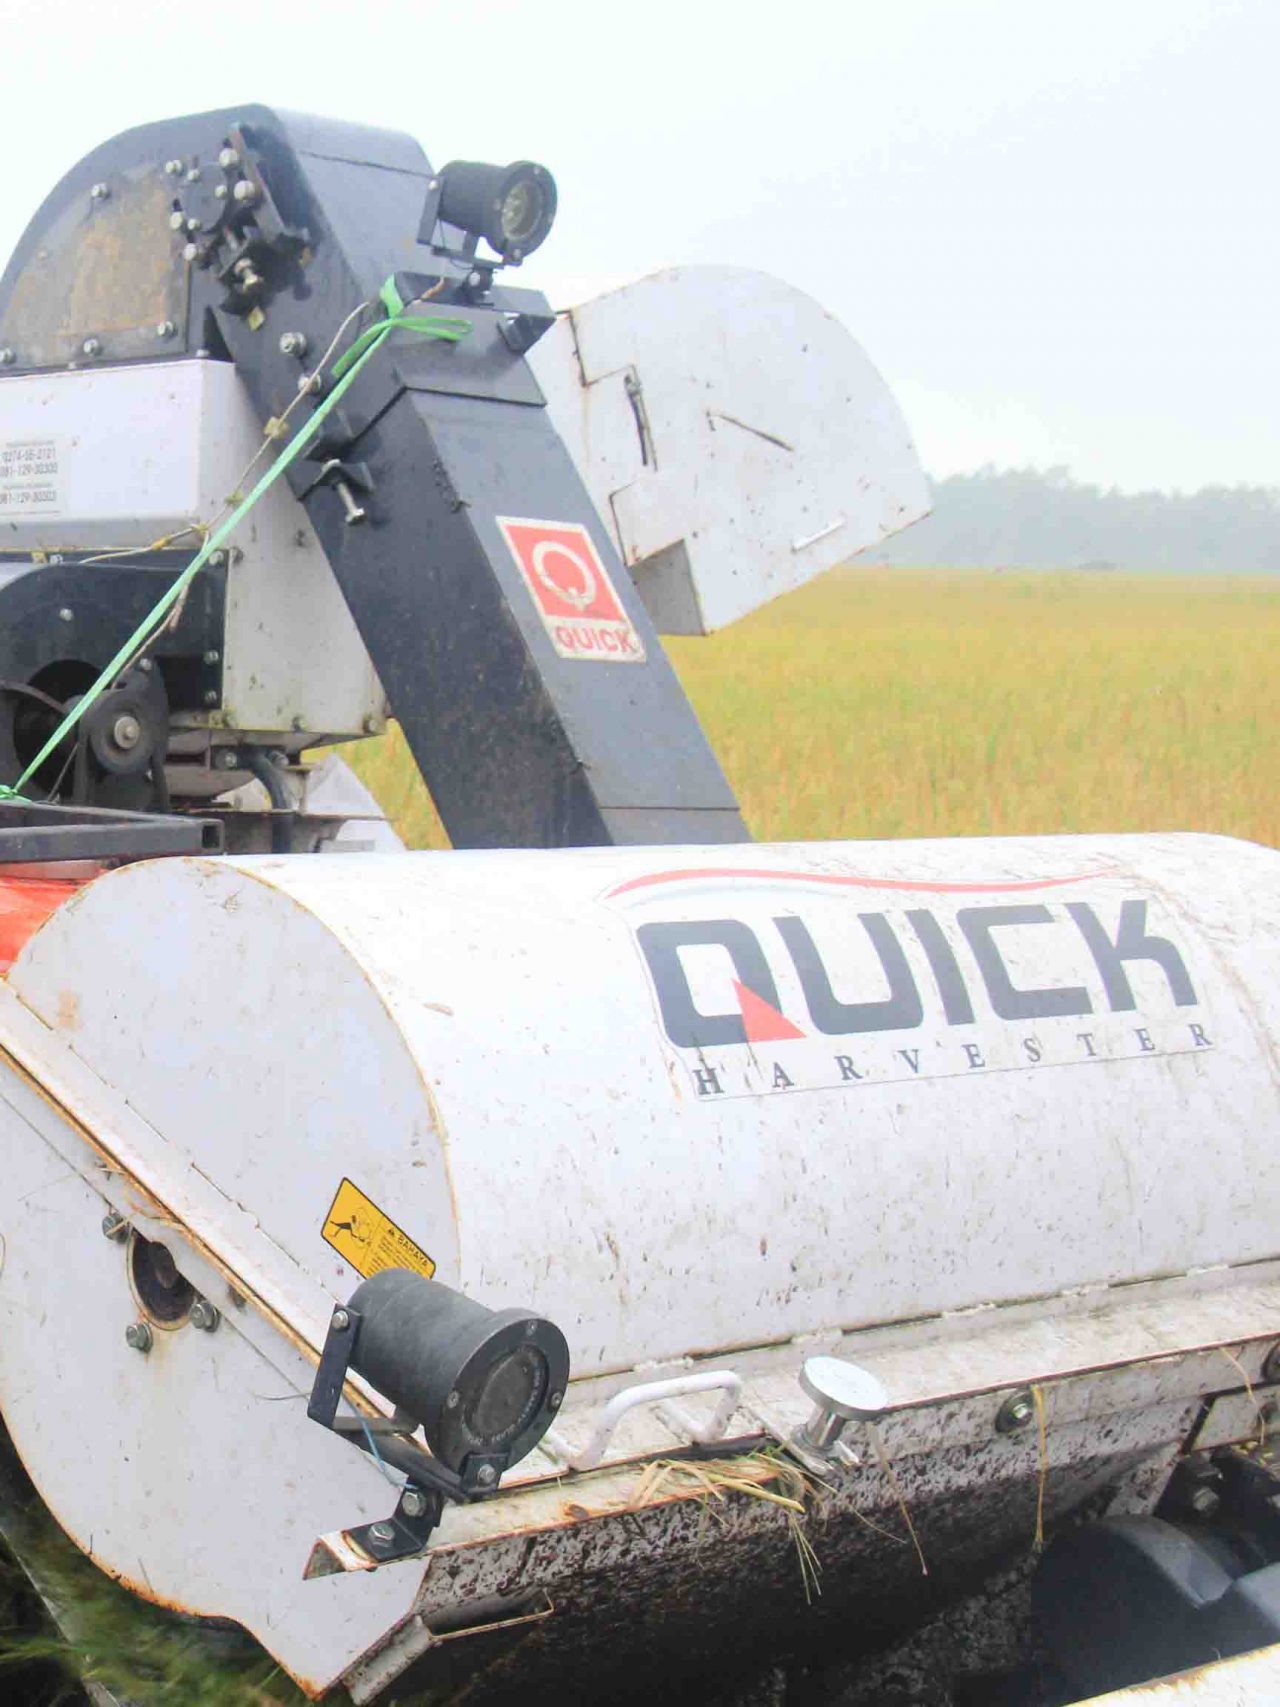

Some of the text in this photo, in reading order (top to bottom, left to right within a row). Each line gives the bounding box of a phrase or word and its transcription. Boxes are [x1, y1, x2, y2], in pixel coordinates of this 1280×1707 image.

[554, 625, 637, 654] QUICK
[636, 900, 1198, 1049] QUICK
[692, 1023, 1214, 1096] HARVESTER
